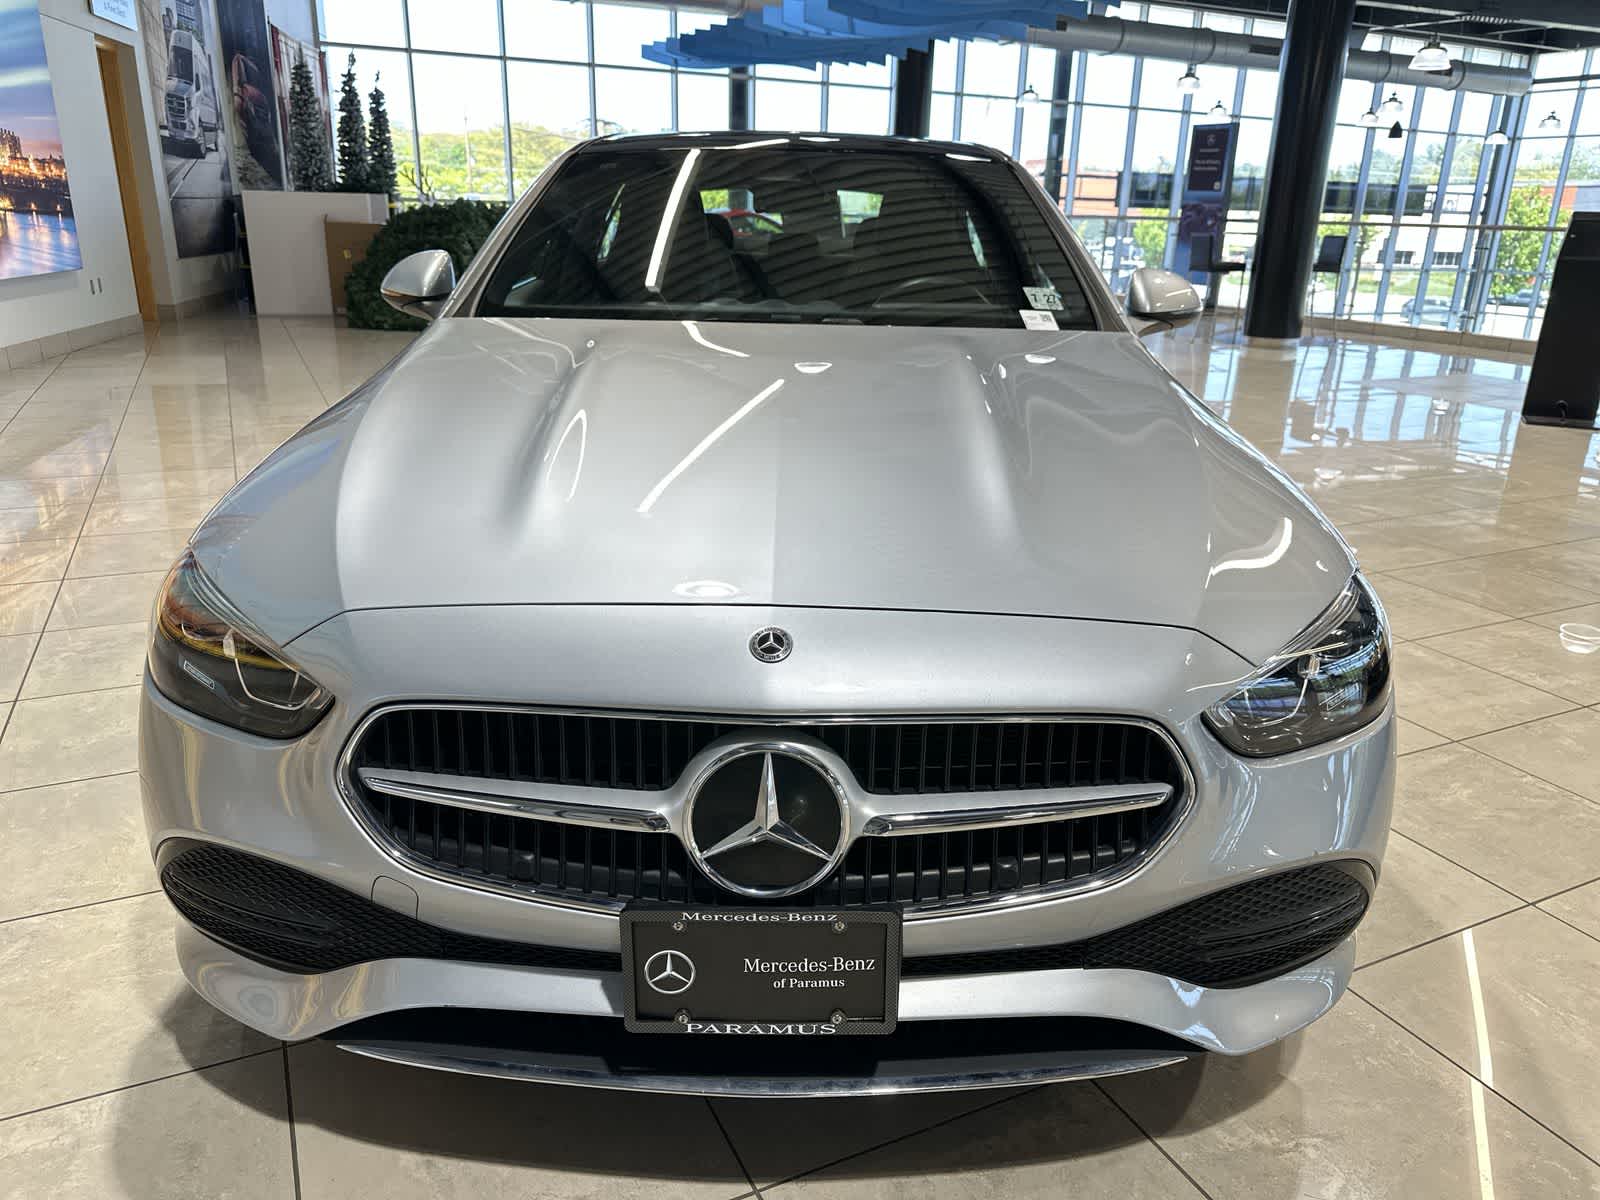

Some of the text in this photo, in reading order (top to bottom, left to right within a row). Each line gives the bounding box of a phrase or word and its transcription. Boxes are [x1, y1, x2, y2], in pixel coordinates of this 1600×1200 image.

[682, 912, 838, 922] Mercedes-Benz
[743, 957, 876, 973] Mercedes-Benz
[773, 978, 845, 988] of Paramus
[685, 1023, 837, 1035] PARAMUS
